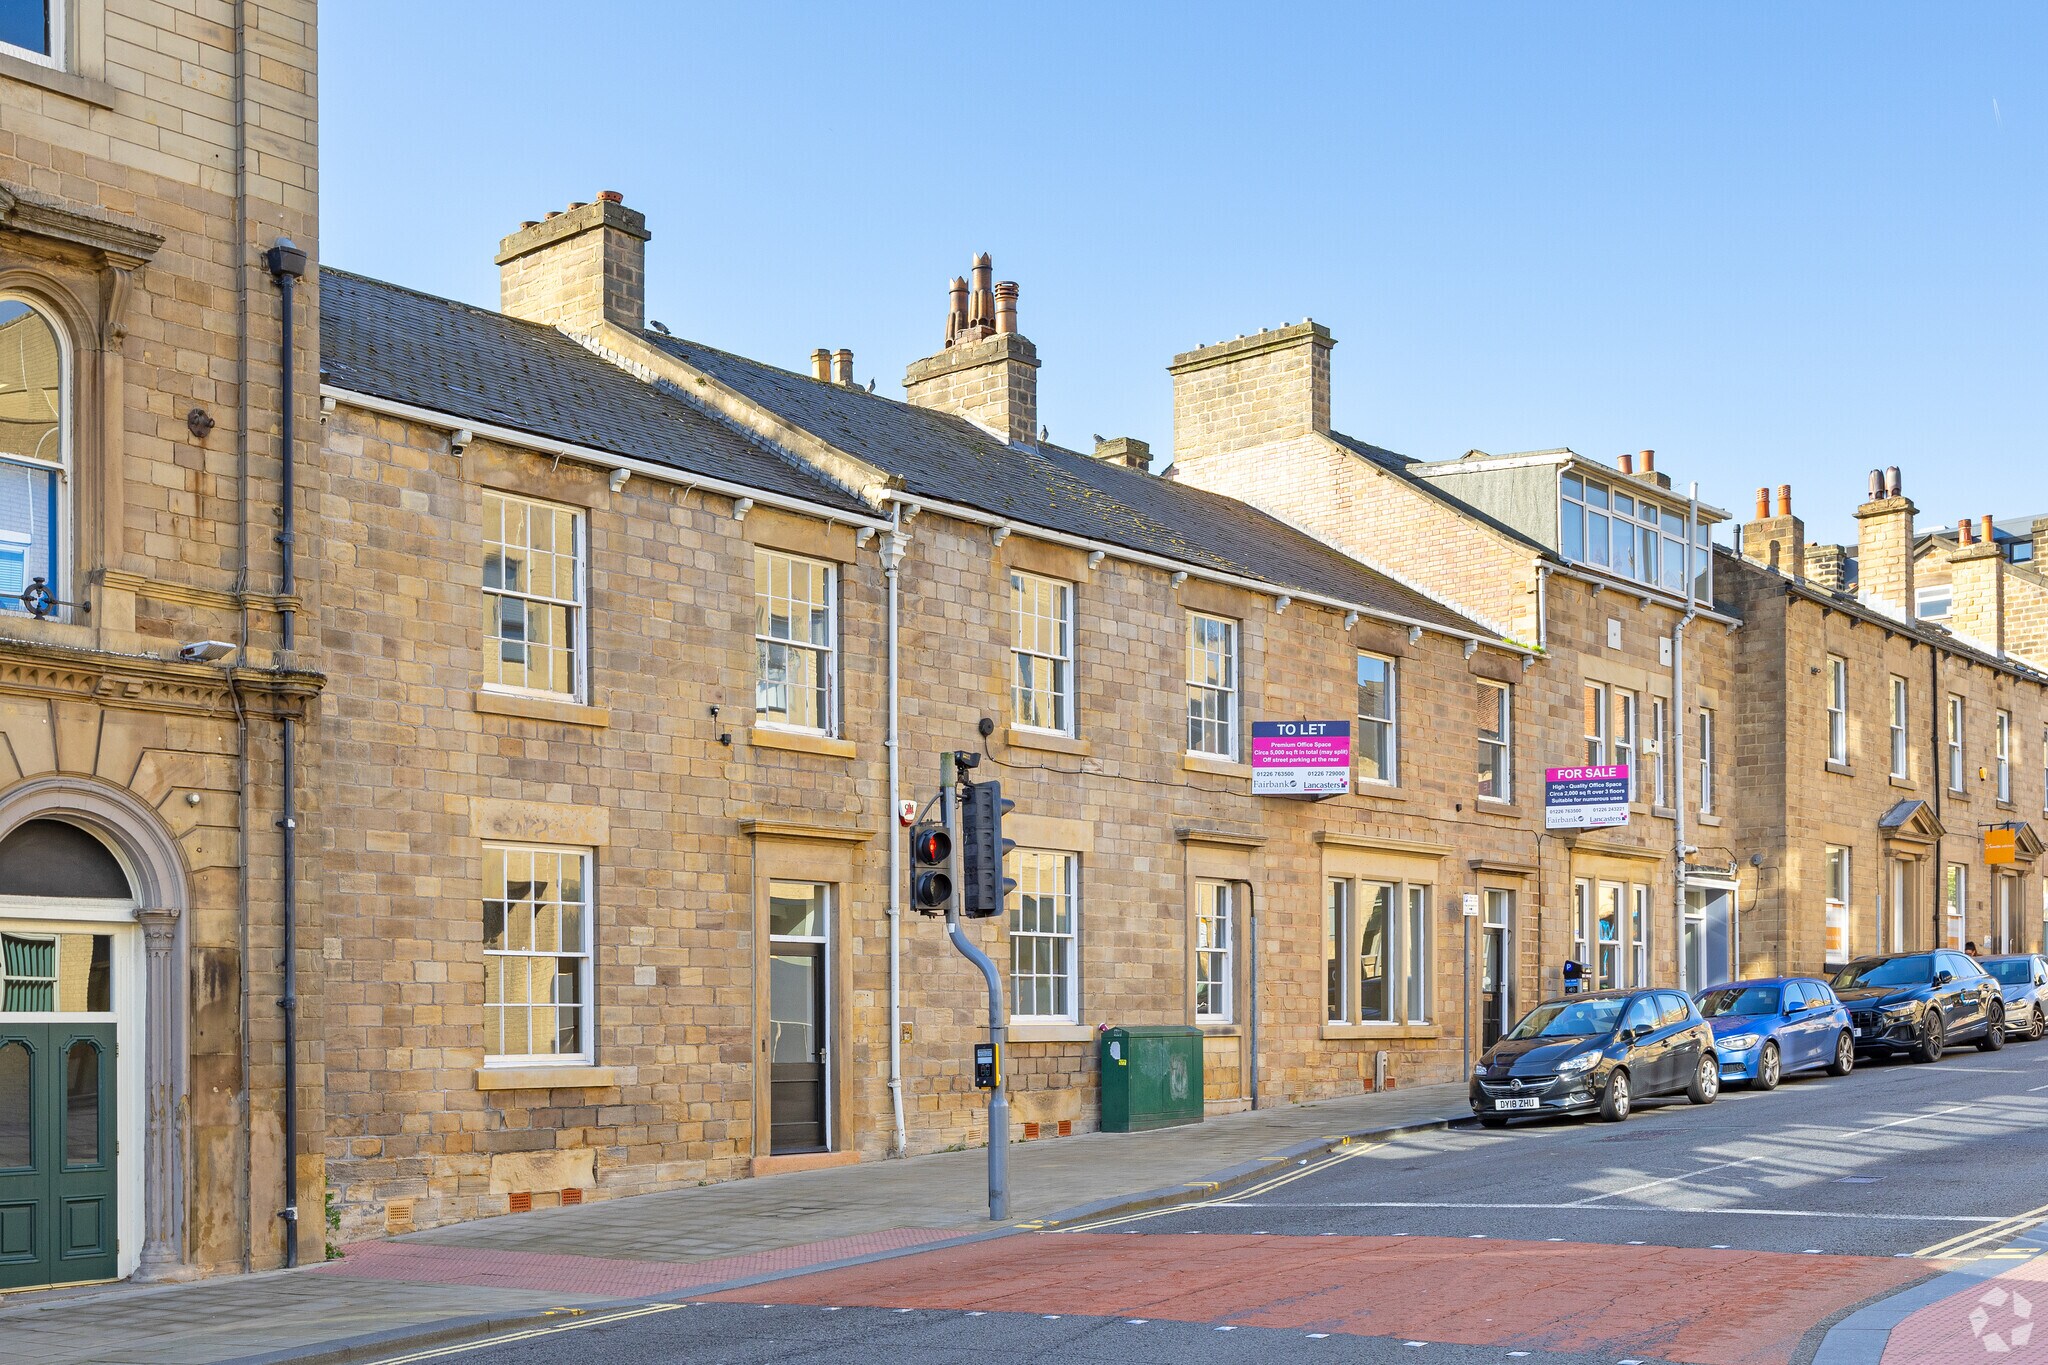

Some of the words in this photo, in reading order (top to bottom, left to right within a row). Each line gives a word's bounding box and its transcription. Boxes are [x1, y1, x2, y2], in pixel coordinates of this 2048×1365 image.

[1277, 724, 1296, 736] TO
[1300, 724, 1326, 735] LET
[1558, 769, 1582, 779] FOR
[1586, 767, 1617, 777] SALE
[1500, 1100, 1516, 1108] DY18
[1519, 1099, 1534, 1107] ZHU
